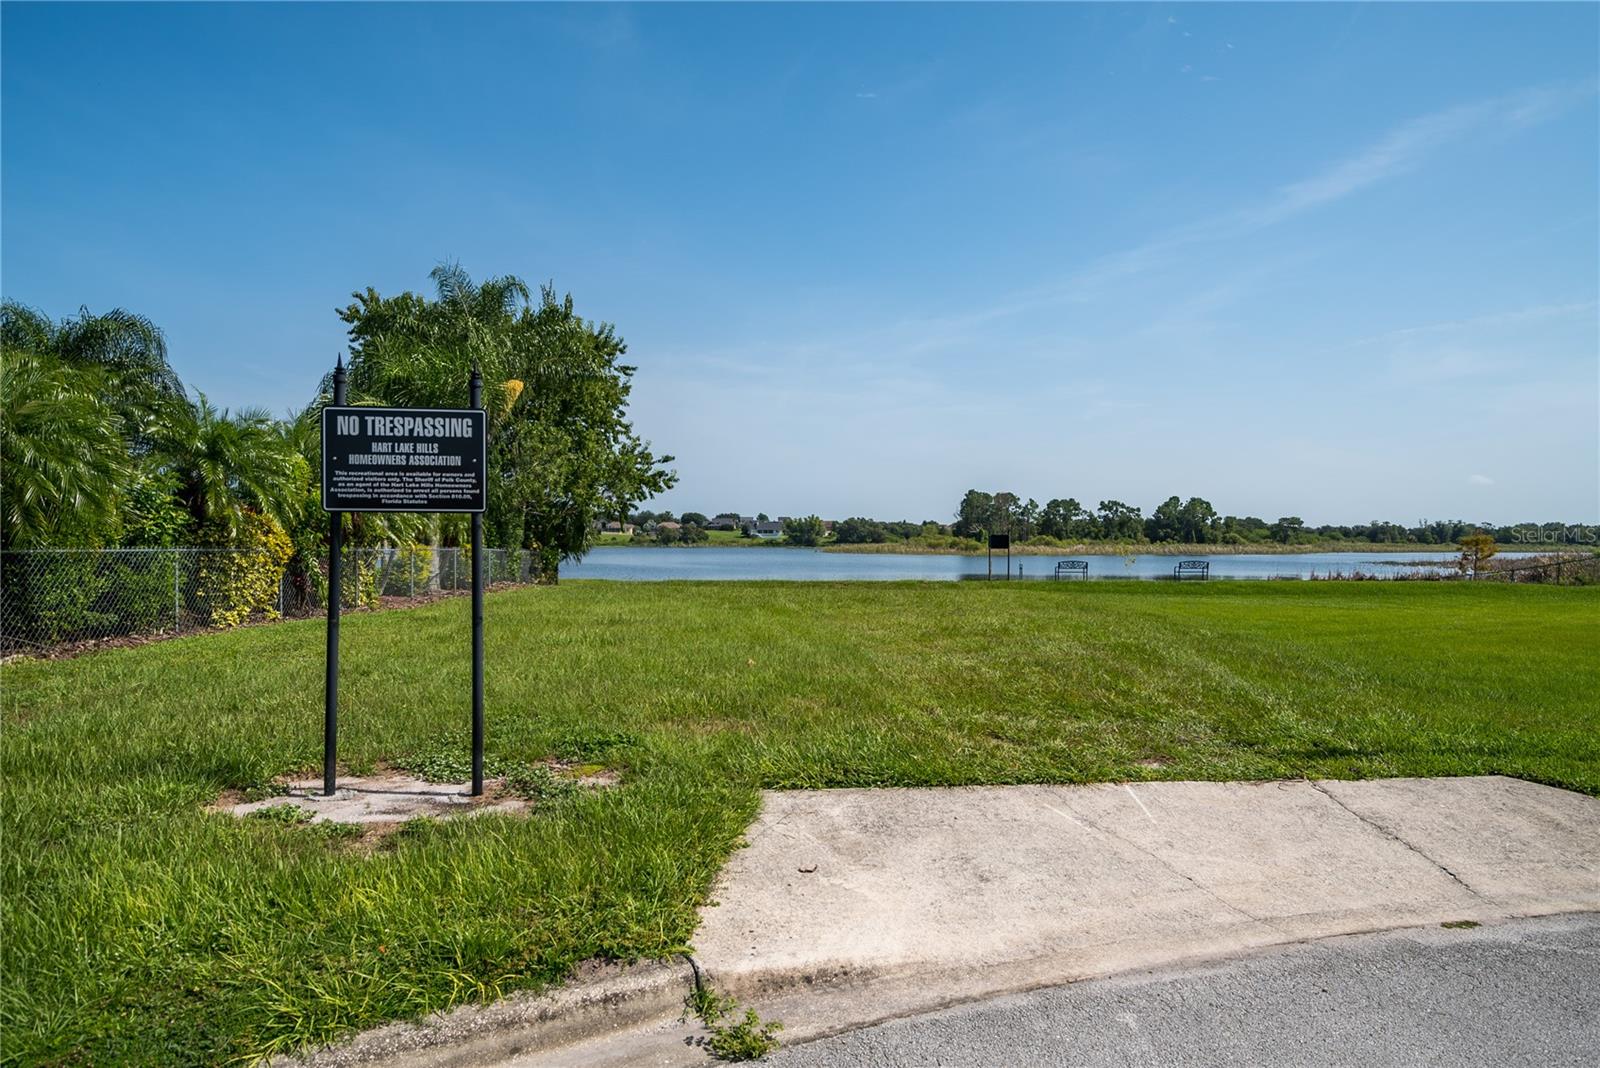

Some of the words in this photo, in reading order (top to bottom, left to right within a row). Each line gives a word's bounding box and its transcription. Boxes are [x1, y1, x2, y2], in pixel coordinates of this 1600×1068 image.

[337, 415, 360, 436] NO
[365, 416, 473, 438] TRESPASSING
[372, 442, 392, 453] HART
[394, 442, 414, 453] LAKE
[416, 443, 439, 454] HILLS
[348, 454, 407, 465] HOMEOWNERS
[408, 455, 461, 466] ASSOCIATION
